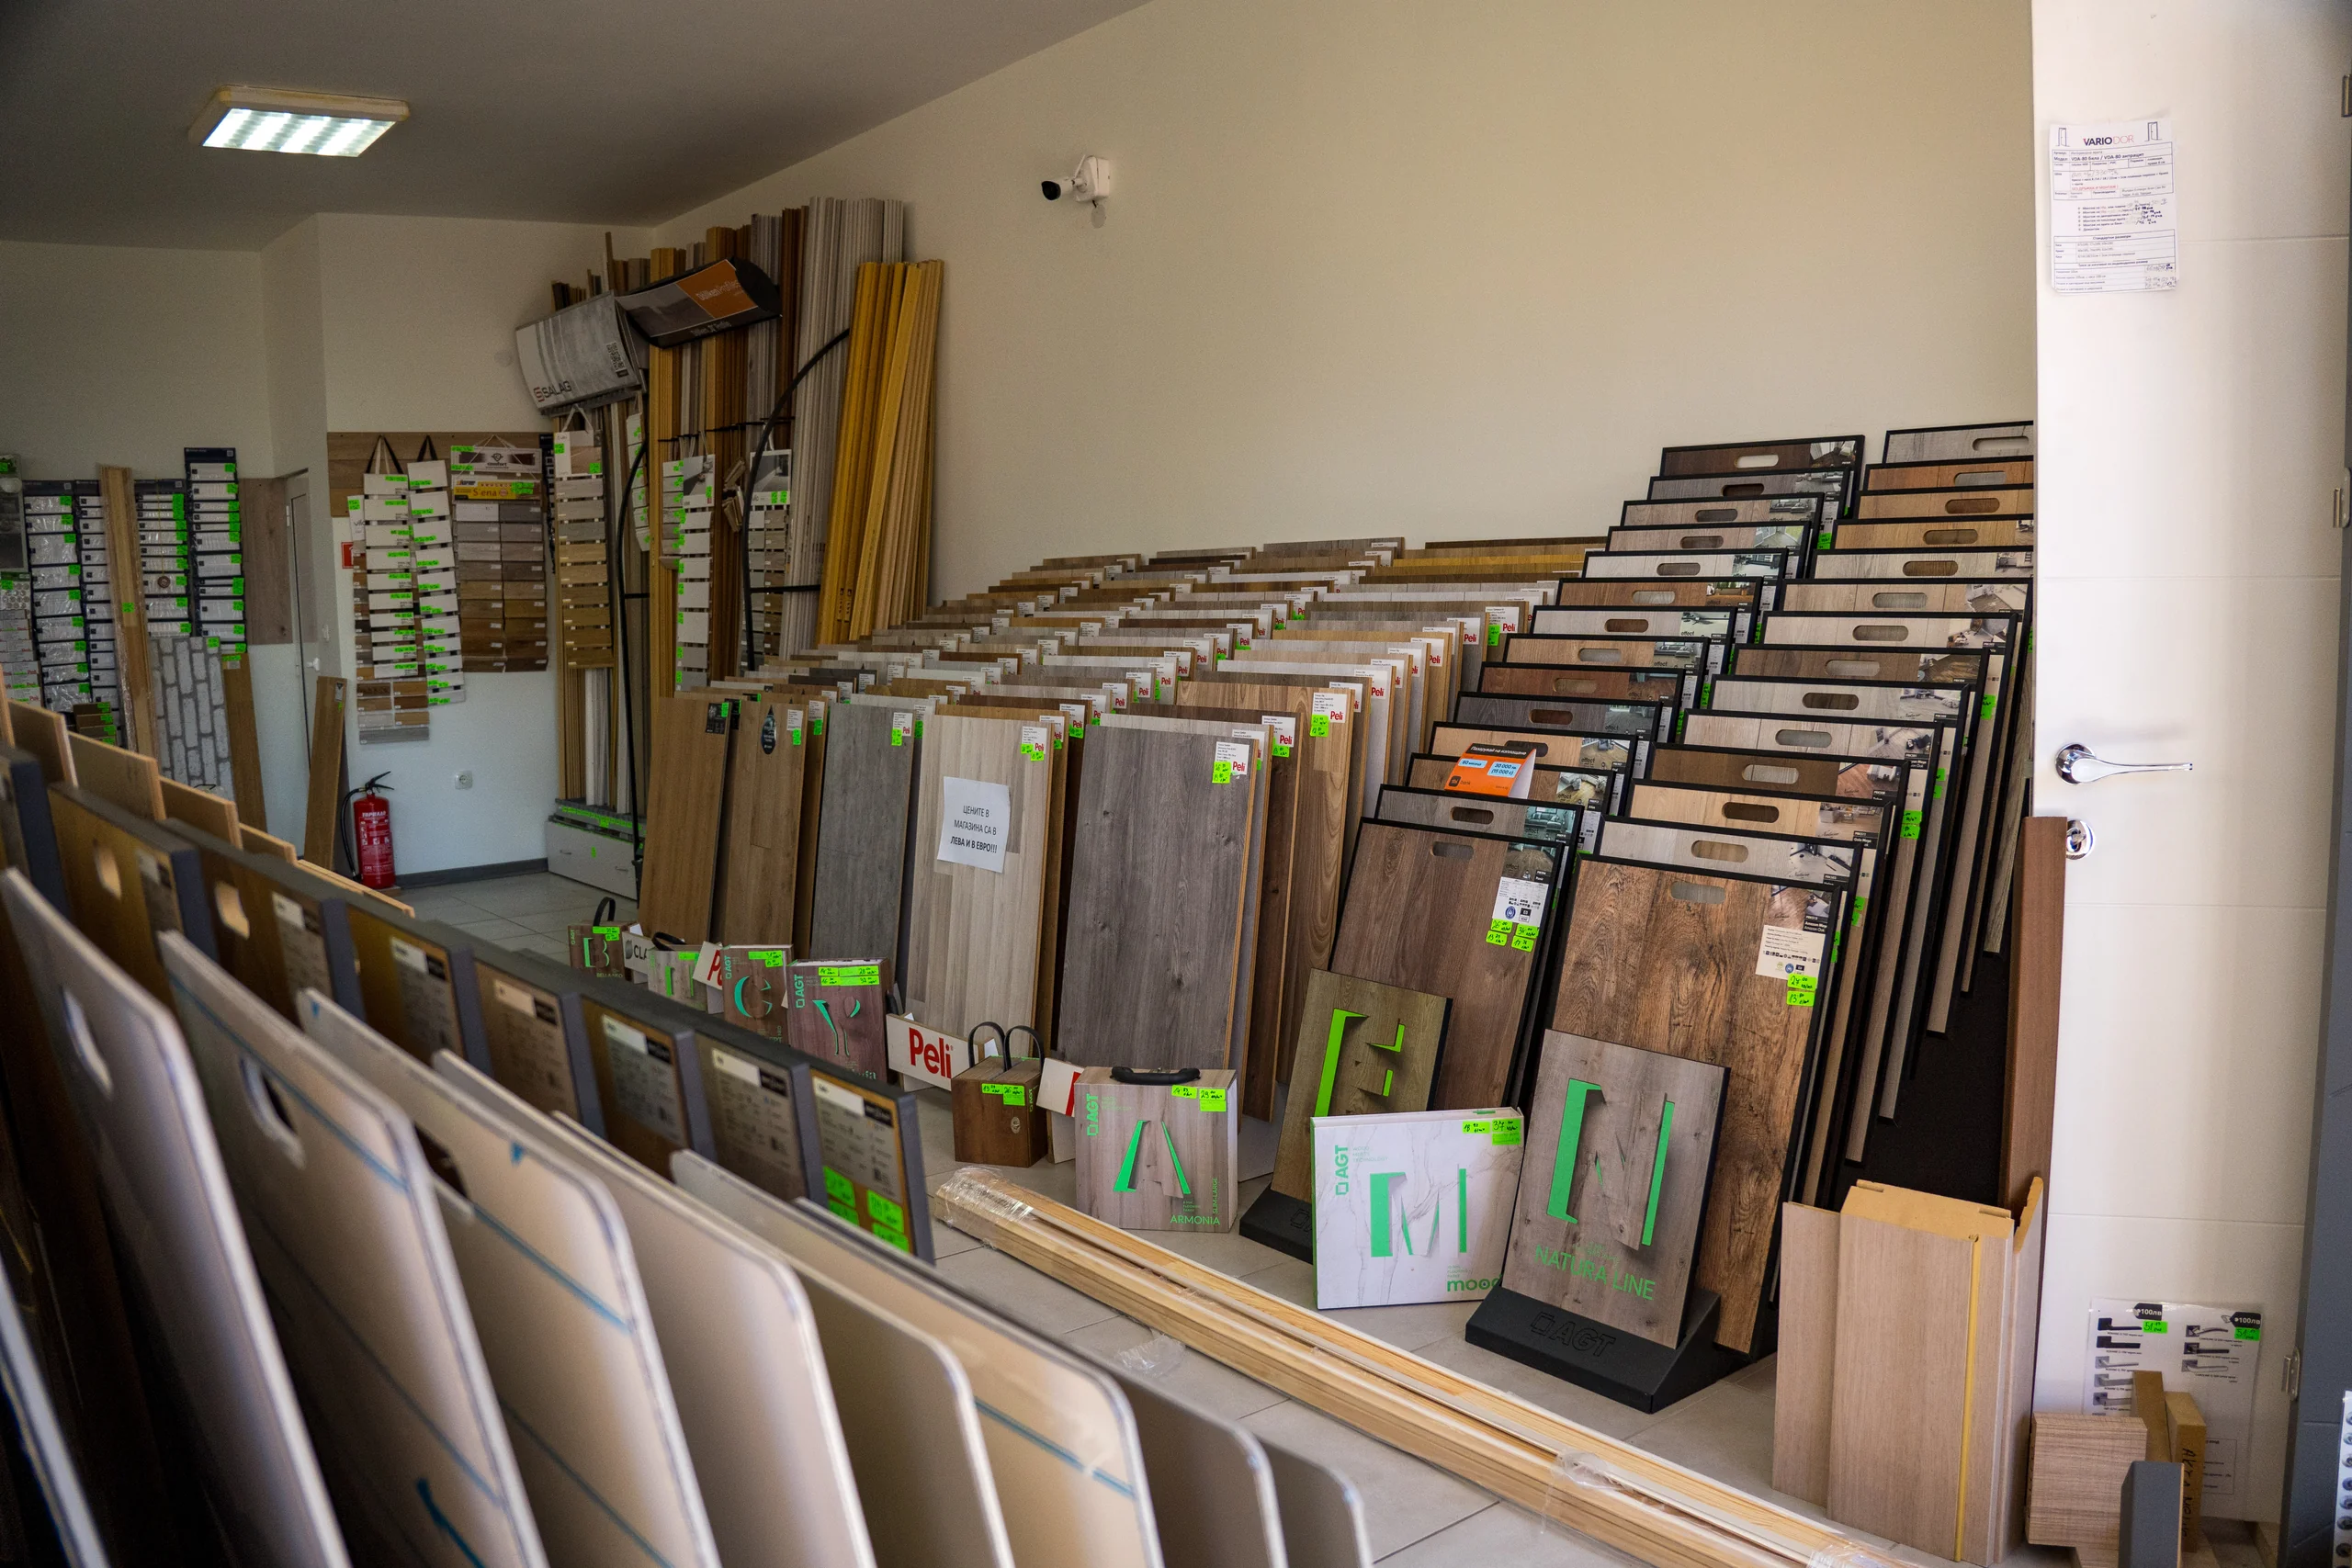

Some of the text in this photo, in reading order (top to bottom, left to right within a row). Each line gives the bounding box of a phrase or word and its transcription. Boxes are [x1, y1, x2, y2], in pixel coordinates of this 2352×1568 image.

[2083, 135, 2134, 146] VARIODOR
[542, 380, 572, 399] SALAG
[472, 489, 497, 497] Sena
[1502, 623, 1516, 631] Peli
[1239, 637, 1250, 646] Peli
[1464, 634, 1476, 642] Peli
[1178, 666, 1188, 674] Peli
[1138, 687, 1149, 696] Peli
[1371, 686, 1384, 696] Peli
[1115, 698, 1125, 706] Peli
[1330, 711, 1343, 721] Peli
[1279, 735, 1293, 745] Peli
[1035, 743, 1045, 751] Peli
[1232, 761, 1246, 772] Peli
[963, 806, 989, 818] ЦЕНИТЕ В
[954, 819, 997, 836] МАГАЗИНА СА В
[950, 836, 998, 853] ЛЕВА И В ЕВРО!!!
[794, 974, 805, 998] AGT
[1789, 993, 1798, 1003] 13
[909, 1027, 953, 1079] Peli
[1200, 1090, 1209, 1099] 29
[1086, 1093, 1099, 1123] AGT
[1463, 1123, 1471, 1132] 18
[1334, 1145, 1349, 1179] AGT
[1170, 1214, 1220, 1225] ARMONIA
[1533, 1244, 1608, 1285] NATURA
[1612, 1271, 1656, 1301] LINE
[2141, 1308, 2162, 1316] 100лв
[2240, 1316, 2261, 1325] 100лв
[2143, 1322, 2154, 1332] 51
[2236, 1328, 2246, 1337] 51
[1549, 1320, 1617, 1358] AGT
